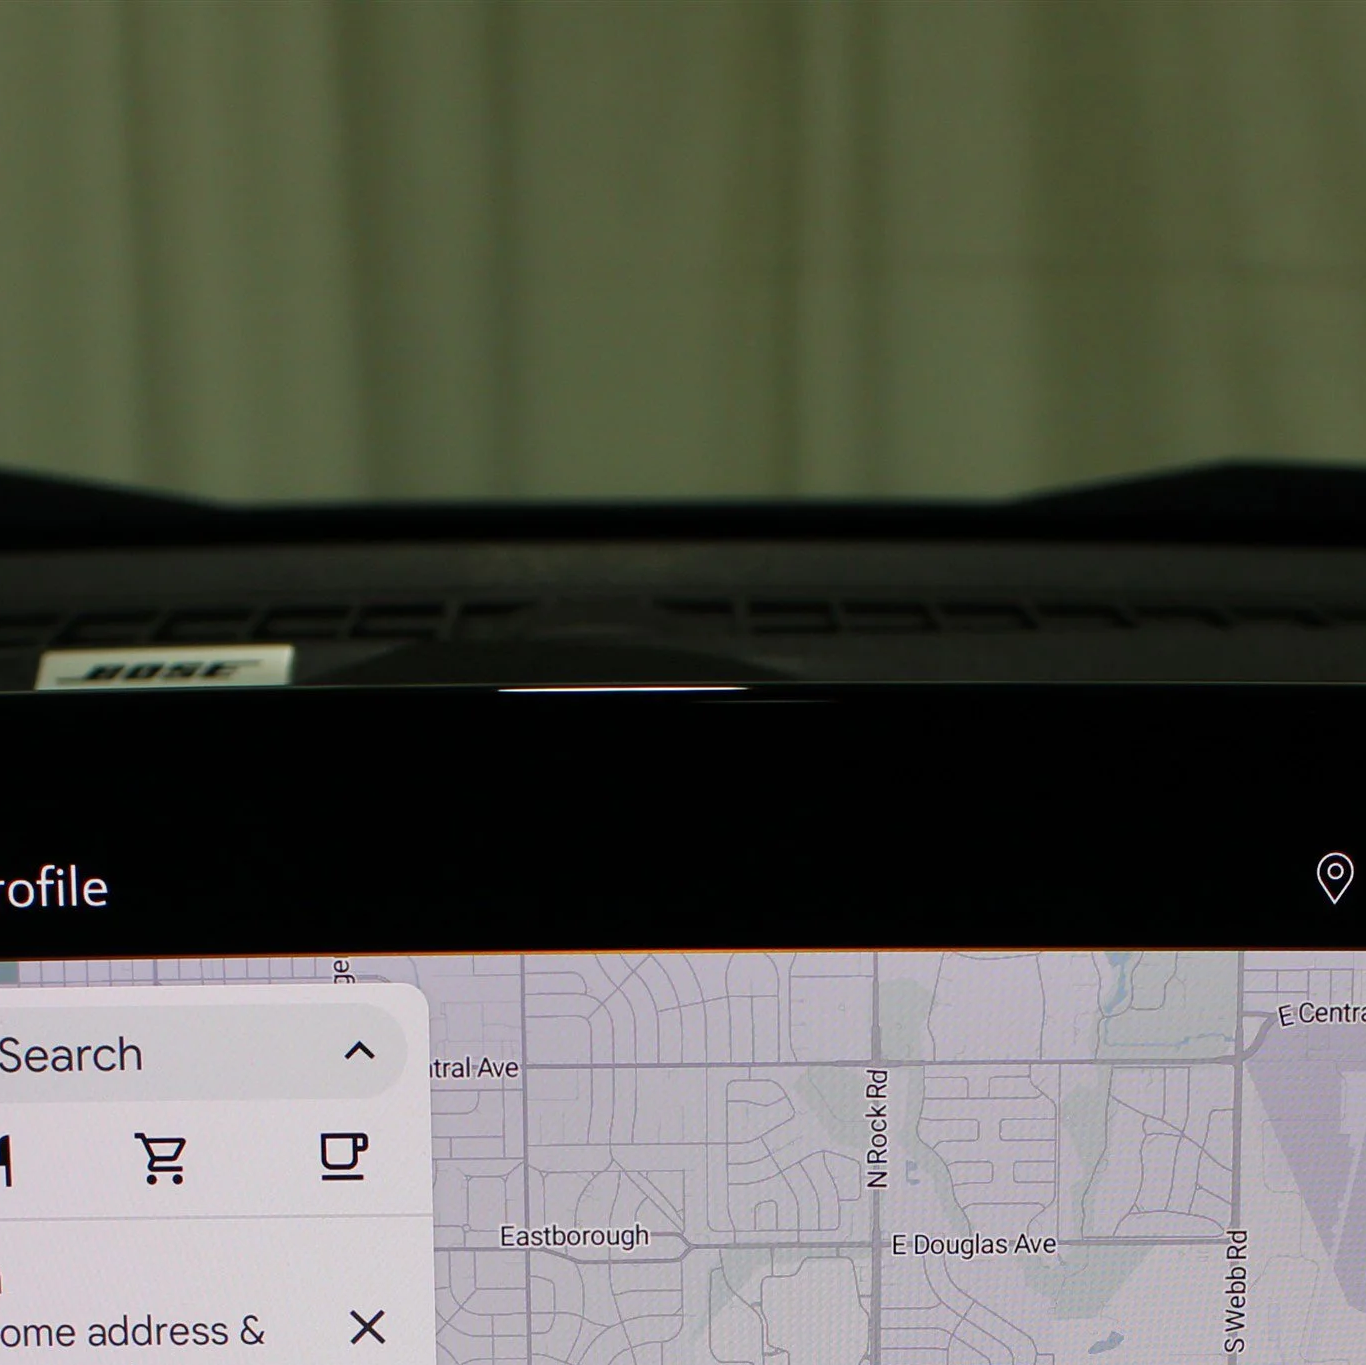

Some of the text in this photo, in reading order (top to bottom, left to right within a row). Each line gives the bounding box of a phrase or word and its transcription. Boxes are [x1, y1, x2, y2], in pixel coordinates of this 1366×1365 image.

[1278, 1004, 1295, 1027] E
[430, 1056, 519, 1078] tral Ave
[865, 1069, 888, 1188] N Rock Rd
[501, 1224, 649, 1251] Eastborough
[893, 1232, 1057, 1260] E Douglas Ave
[1224, 1230, 1248, 1353] S Webb Rd
[88, 1314, 229, 1347] address
[240, 1314, 265, 1345] &
